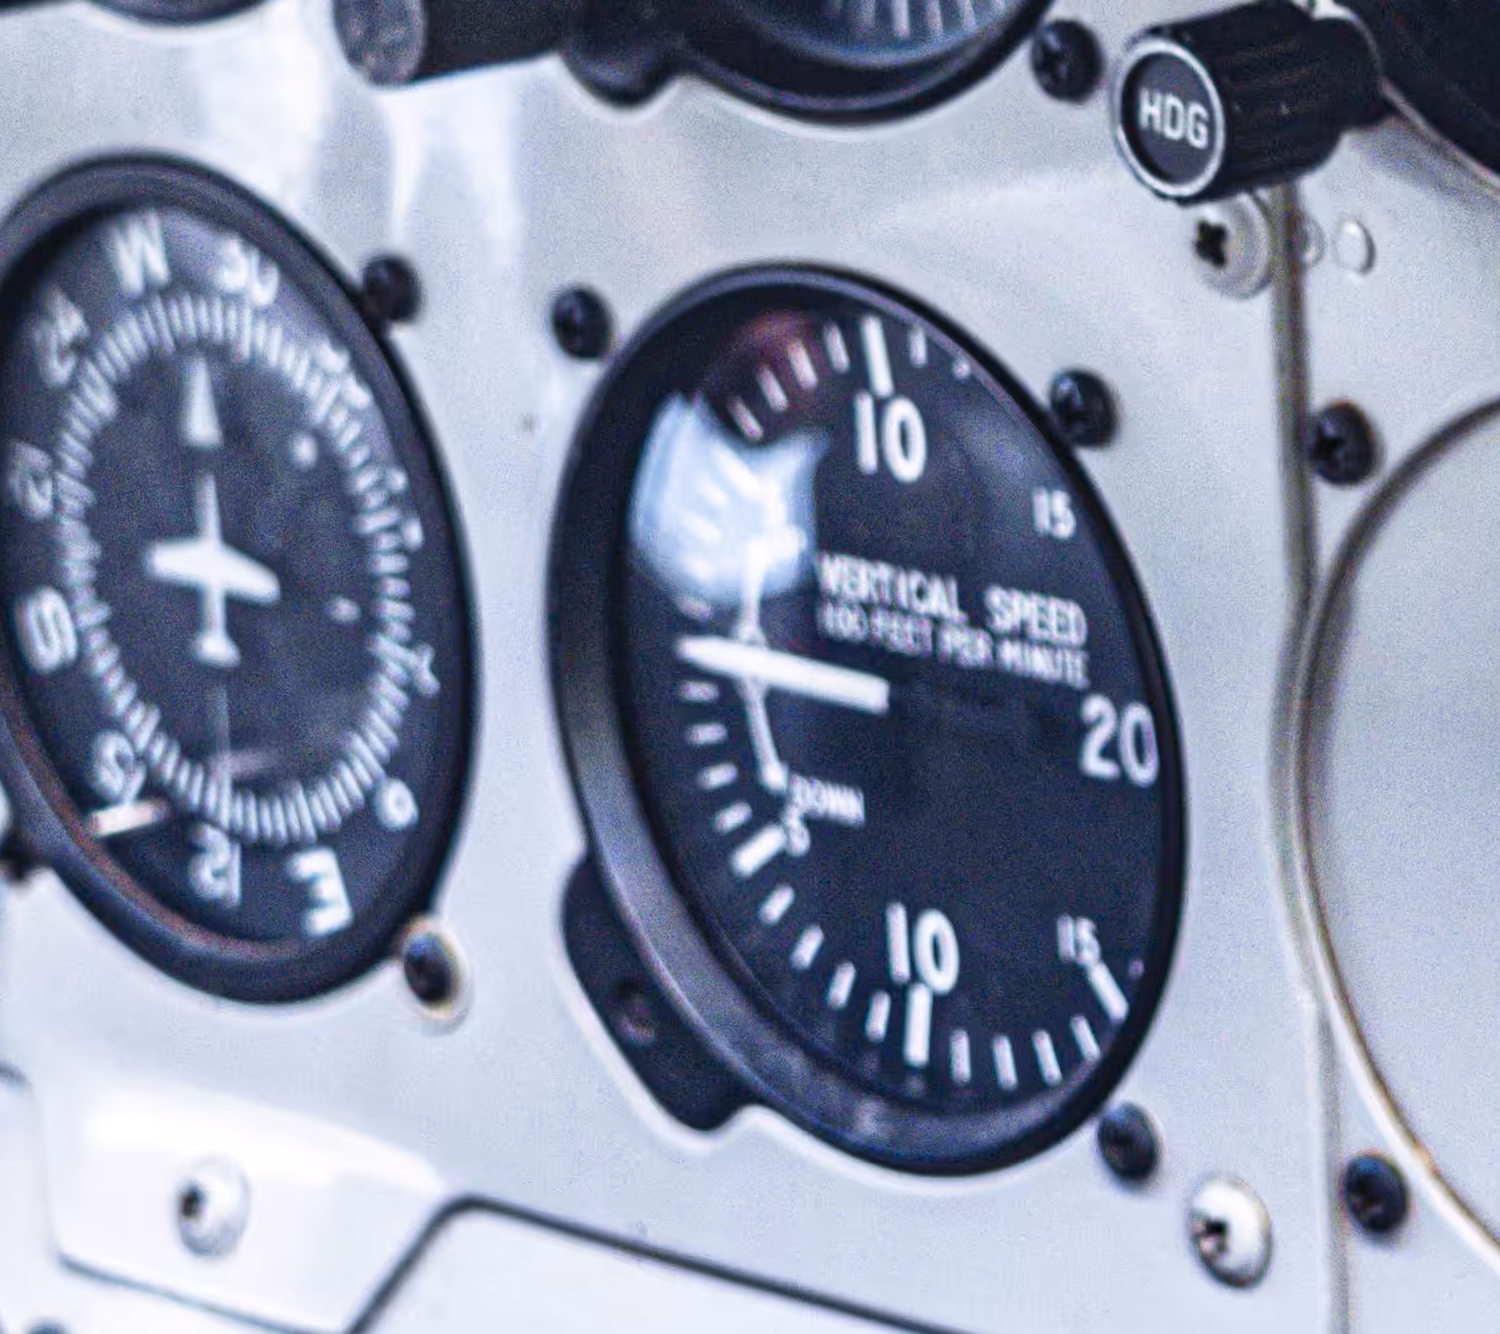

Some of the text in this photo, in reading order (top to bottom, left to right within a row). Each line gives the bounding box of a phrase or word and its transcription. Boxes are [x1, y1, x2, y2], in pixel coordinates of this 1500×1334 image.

[1138, 86, 1209, 150] HDG
[855, 391, 928, 483] 10
[1032, 487, 1078, 540] 15
[17, 585, 79, 672] S
[816, 552, 1088, 649] VERTICAL SPEED
[870, 607, 933, 658] FEET
[936, 618, 994, 667] PER
[997, 638, 1090, 690] MINUTE
[1080, 693, 1161, 786] 20
[788, 774, 866, 827] DOWN
[886, 902, 960, 996] 10
[1058, 914, 1101, 965] 15
